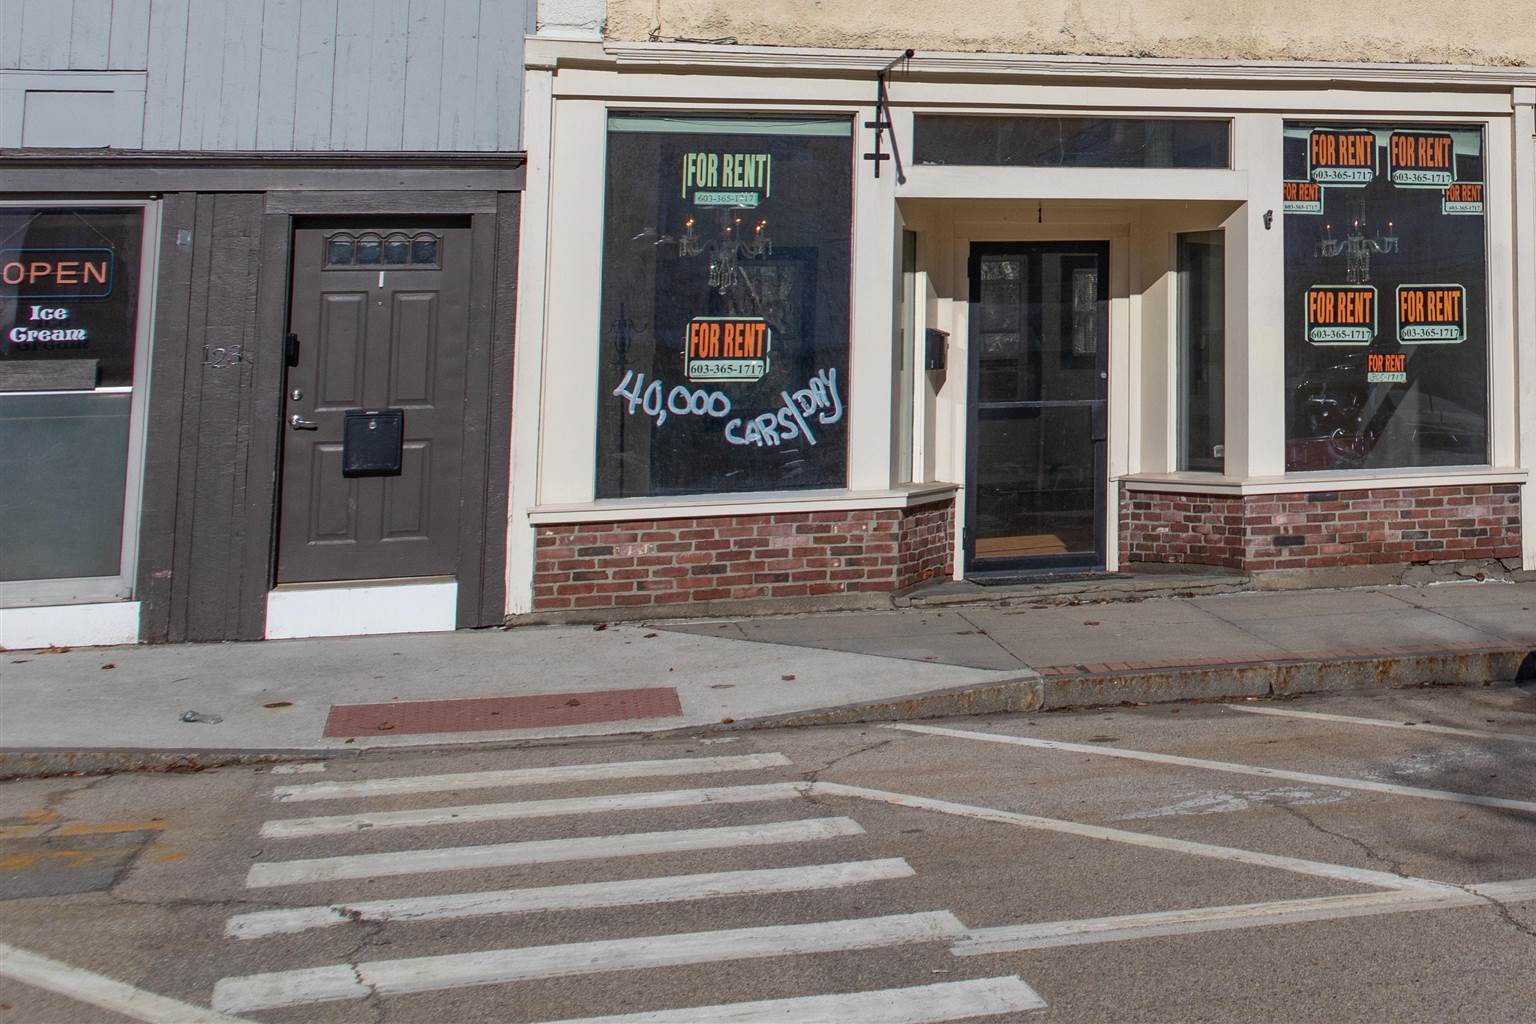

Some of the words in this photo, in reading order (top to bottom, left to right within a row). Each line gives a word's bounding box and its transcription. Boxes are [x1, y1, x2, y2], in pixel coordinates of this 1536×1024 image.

[1312, 134, 1335, 166] FOR
[1339, 134, 1373, 166] RENT
[1391, 136, 1414, 167] FOR
[1418, 136, 1451, 168] RENT
[687, 152, 718, 187] FOR
[722, 153, 766, 187] RENT
[1313, 170, 1372, 182] 603-365-1717
[1393, 172, 1450, 183] 603-365-1717
[1283, 183, 1297, 201] FOR
[1299, 183, 1318, 201] RENT
[1446, 184, 1460, 201] FOR
[1462, 185, 1482, 202] RENT
[3, 261, 107, 285] OPEN
[30, 305, 68, 320] Ice
[1310, 291, 1334, 323] FOR
[1337, 291, 1372, 323] RENT
[1401, 290, 1424, 322] FOR
[1427, 290, 1461, 322] RENT
[690, 323, 720, 357] FOR
[723, 323, 765, 357] RENT
[1312, 330, 1371, 340] 603-365-1717
[1402, 328, 1459, 338] 603-365-1717
[691, 364, 762, 374] 603-365-1717
[1368, 354, 1383, 372] FOR
[1385, 354, 1405, 372] RENT
[613, 370, 731, 426] 40,000
